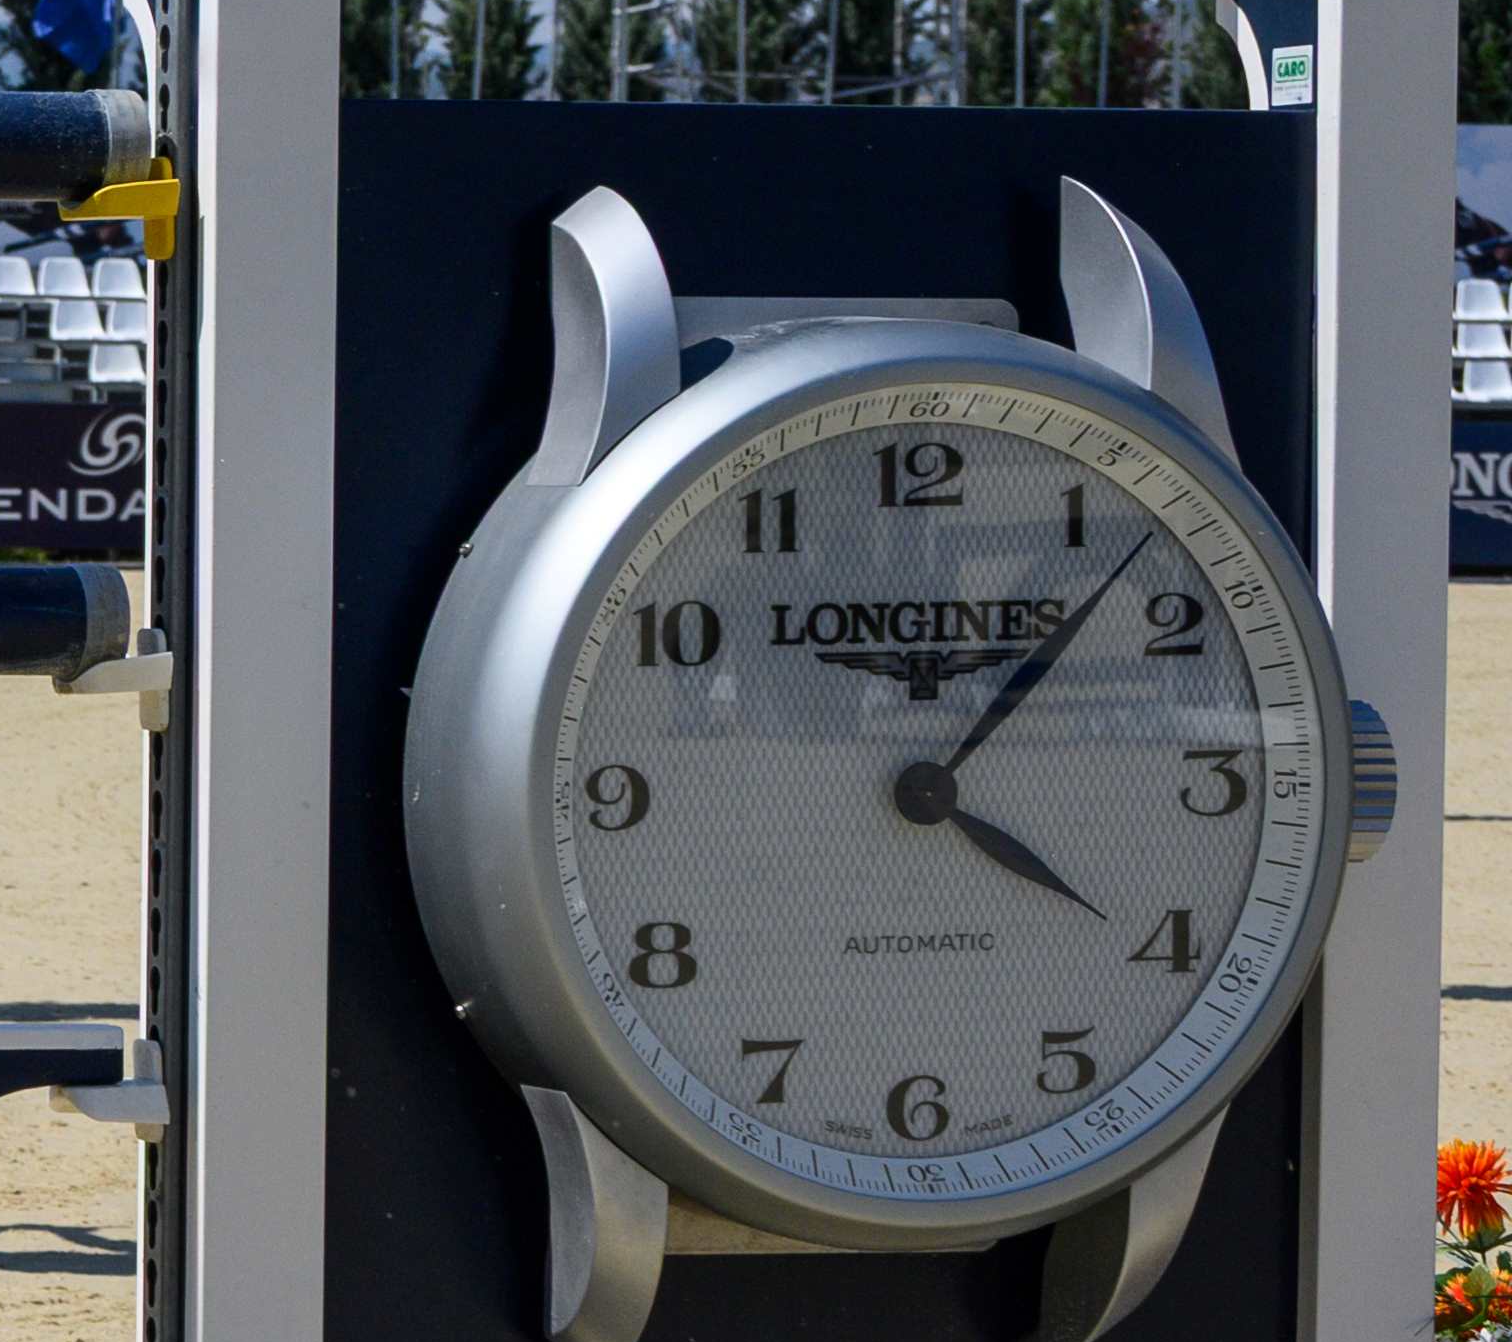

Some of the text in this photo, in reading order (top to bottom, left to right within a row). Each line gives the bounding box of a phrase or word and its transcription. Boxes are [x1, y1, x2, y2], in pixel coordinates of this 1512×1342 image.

[1277, 60, 1306, 78] CARO
[909, 401, 950, 418] 60
[872, 442, 964, 507] 12
[1097, 448, 1123, 467] 5
[738, 488, 800, 553] 11
[1061, 483, 1086, 547] 1
[771, 600, 1065, 645] LONGINES
[1144, 592, 1204, 656] 2
[1223, 580, 1254, 610] 10
[632, 600, 721, 667] 10
[585, 765, 650, 831] 9
[1180, 750, 1247, 816] 3
[1273, 769, 1297, 799] 15
[629, 922, 697, 988] 8
[844, 932, 995, 955] AUTOMATIC
[1126, 909, 1202, 973] 4
[1218, 953, 1253, 993] 20
[741, 1039, 806, 1104] 7
[1037, 1026, 1096, 1094] 5
[825, 1114, 1013, 1140] SWISS MADE
[886, 1075, 950, 1141] 6
